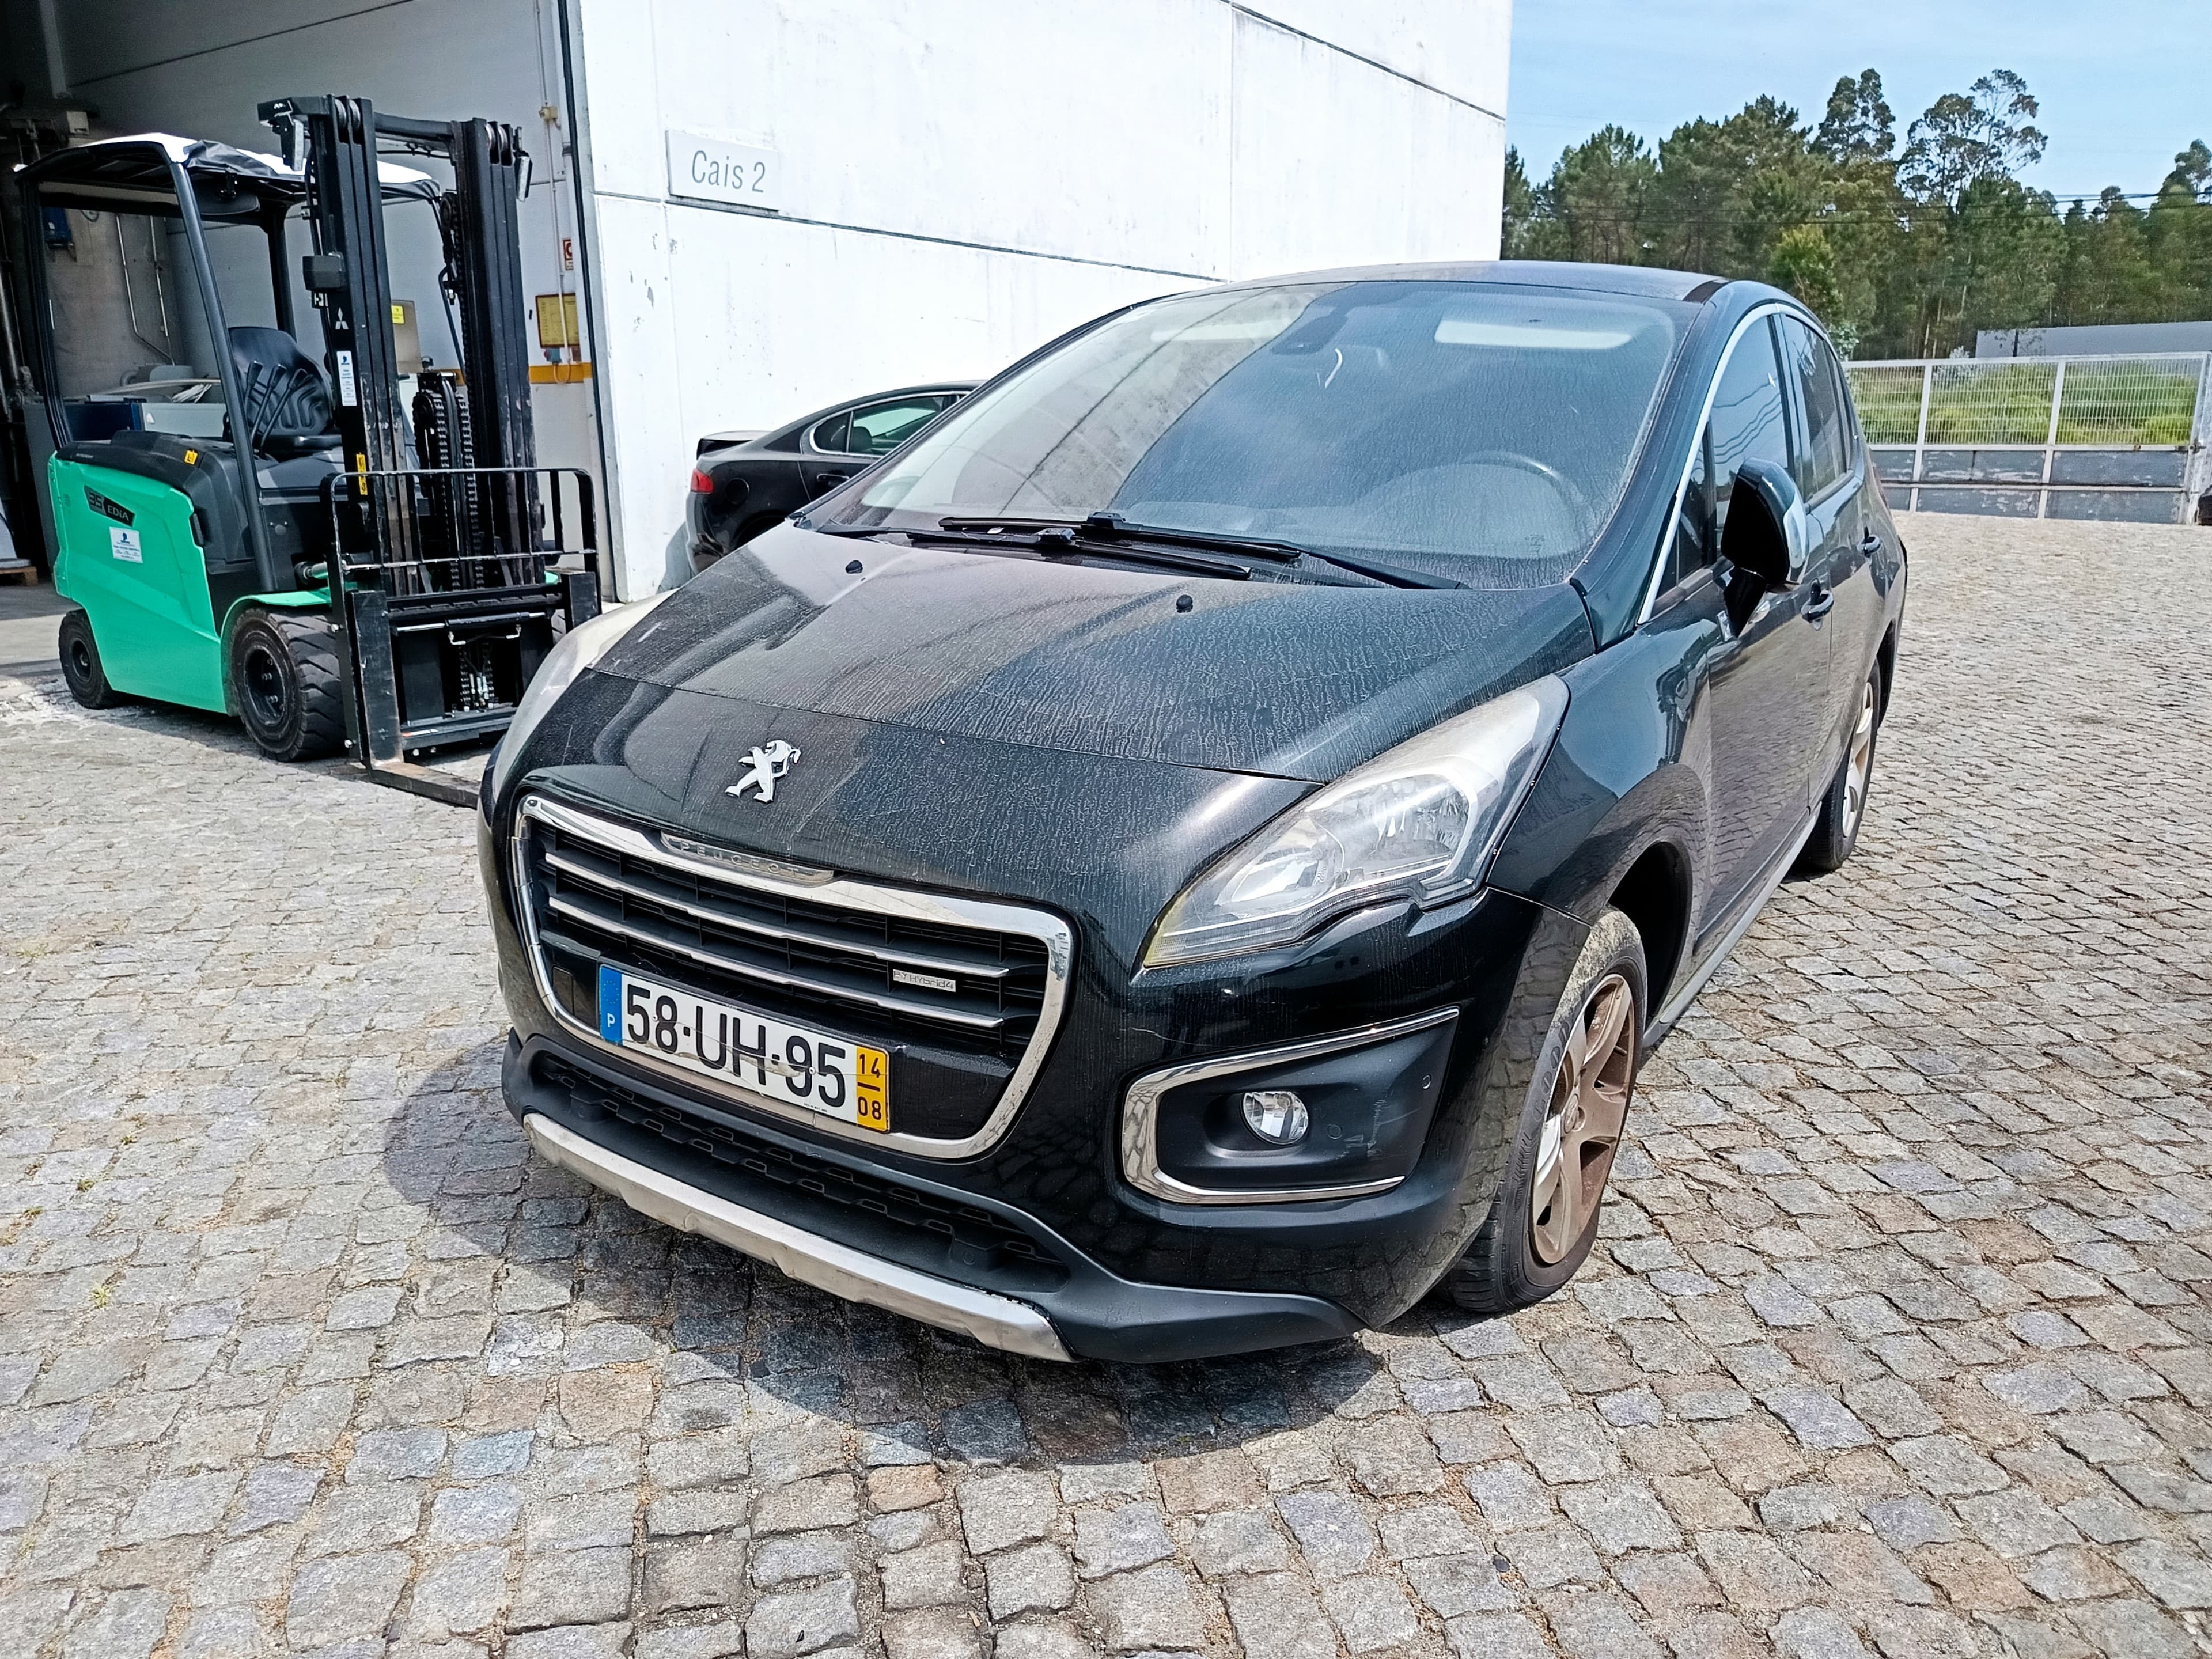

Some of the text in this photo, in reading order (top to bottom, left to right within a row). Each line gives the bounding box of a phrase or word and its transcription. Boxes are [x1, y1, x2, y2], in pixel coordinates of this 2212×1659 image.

[692, 150, 766, 193] Cais 2
[607, 1012, 616, 1028] P
[859, 1053, 881, 1079] 14
[858, 1096, 882, 1120] 08
